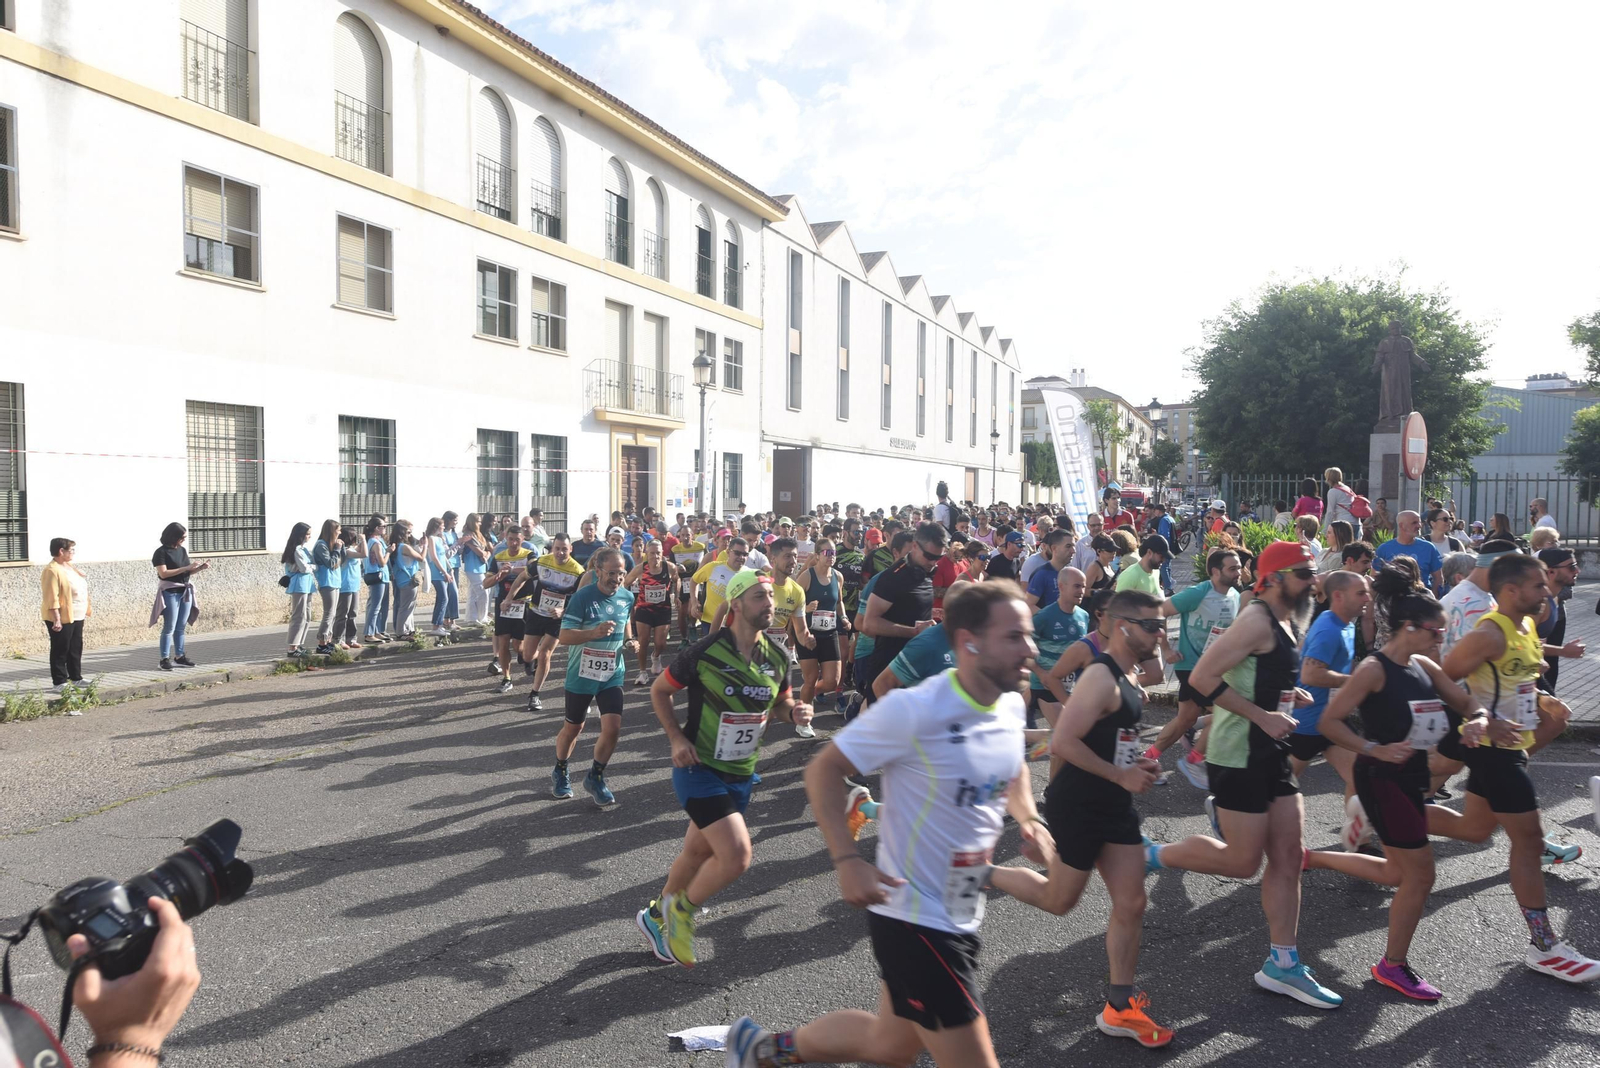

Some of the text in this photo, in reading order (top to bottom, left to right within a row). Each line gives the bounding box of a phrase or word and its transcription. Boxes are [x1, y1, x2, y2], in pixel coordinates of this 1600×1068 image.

[544, 598, 560, 607] 277
[820, 619, 828, 627] 18
[587, 659, 608, 672] 193
[734, 729, 754, 744] 25
